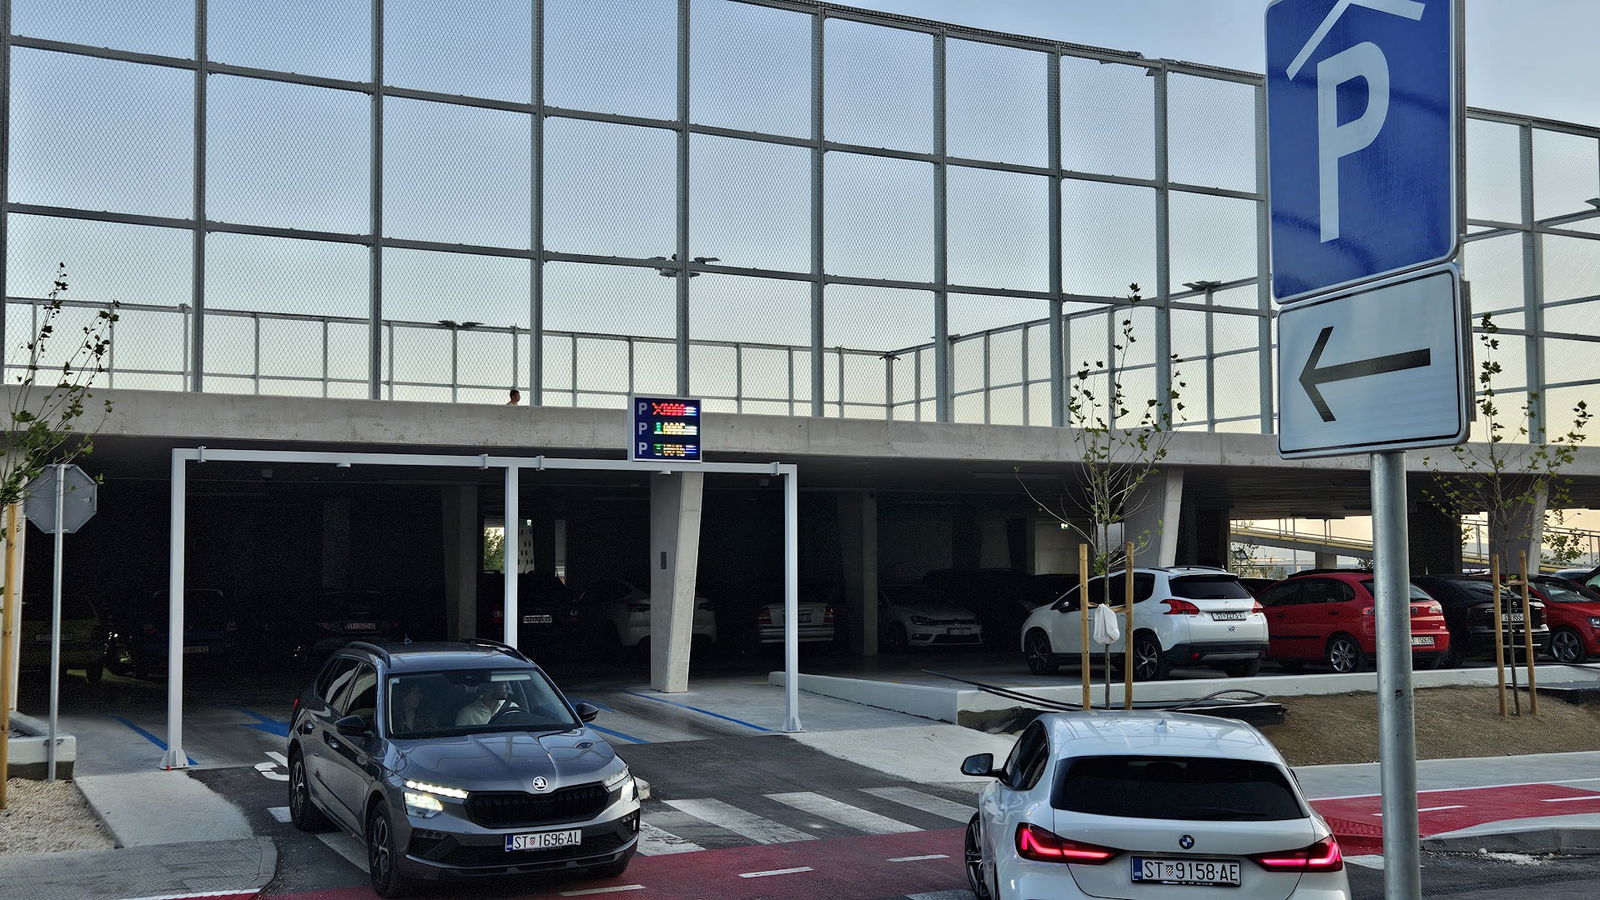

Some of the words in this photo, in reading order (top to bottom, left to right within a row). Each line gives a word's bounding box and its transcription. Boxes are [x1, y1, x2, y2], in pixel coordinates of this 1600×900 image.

[1317, 41, 1390, 243] P
[638, 402, 648, 415] P
[638, 422, 648, 435] P
[638, 442, 648, 455] P
[514, 836, 529, 849] ST
[1144, 861, 1164, 878] ST
